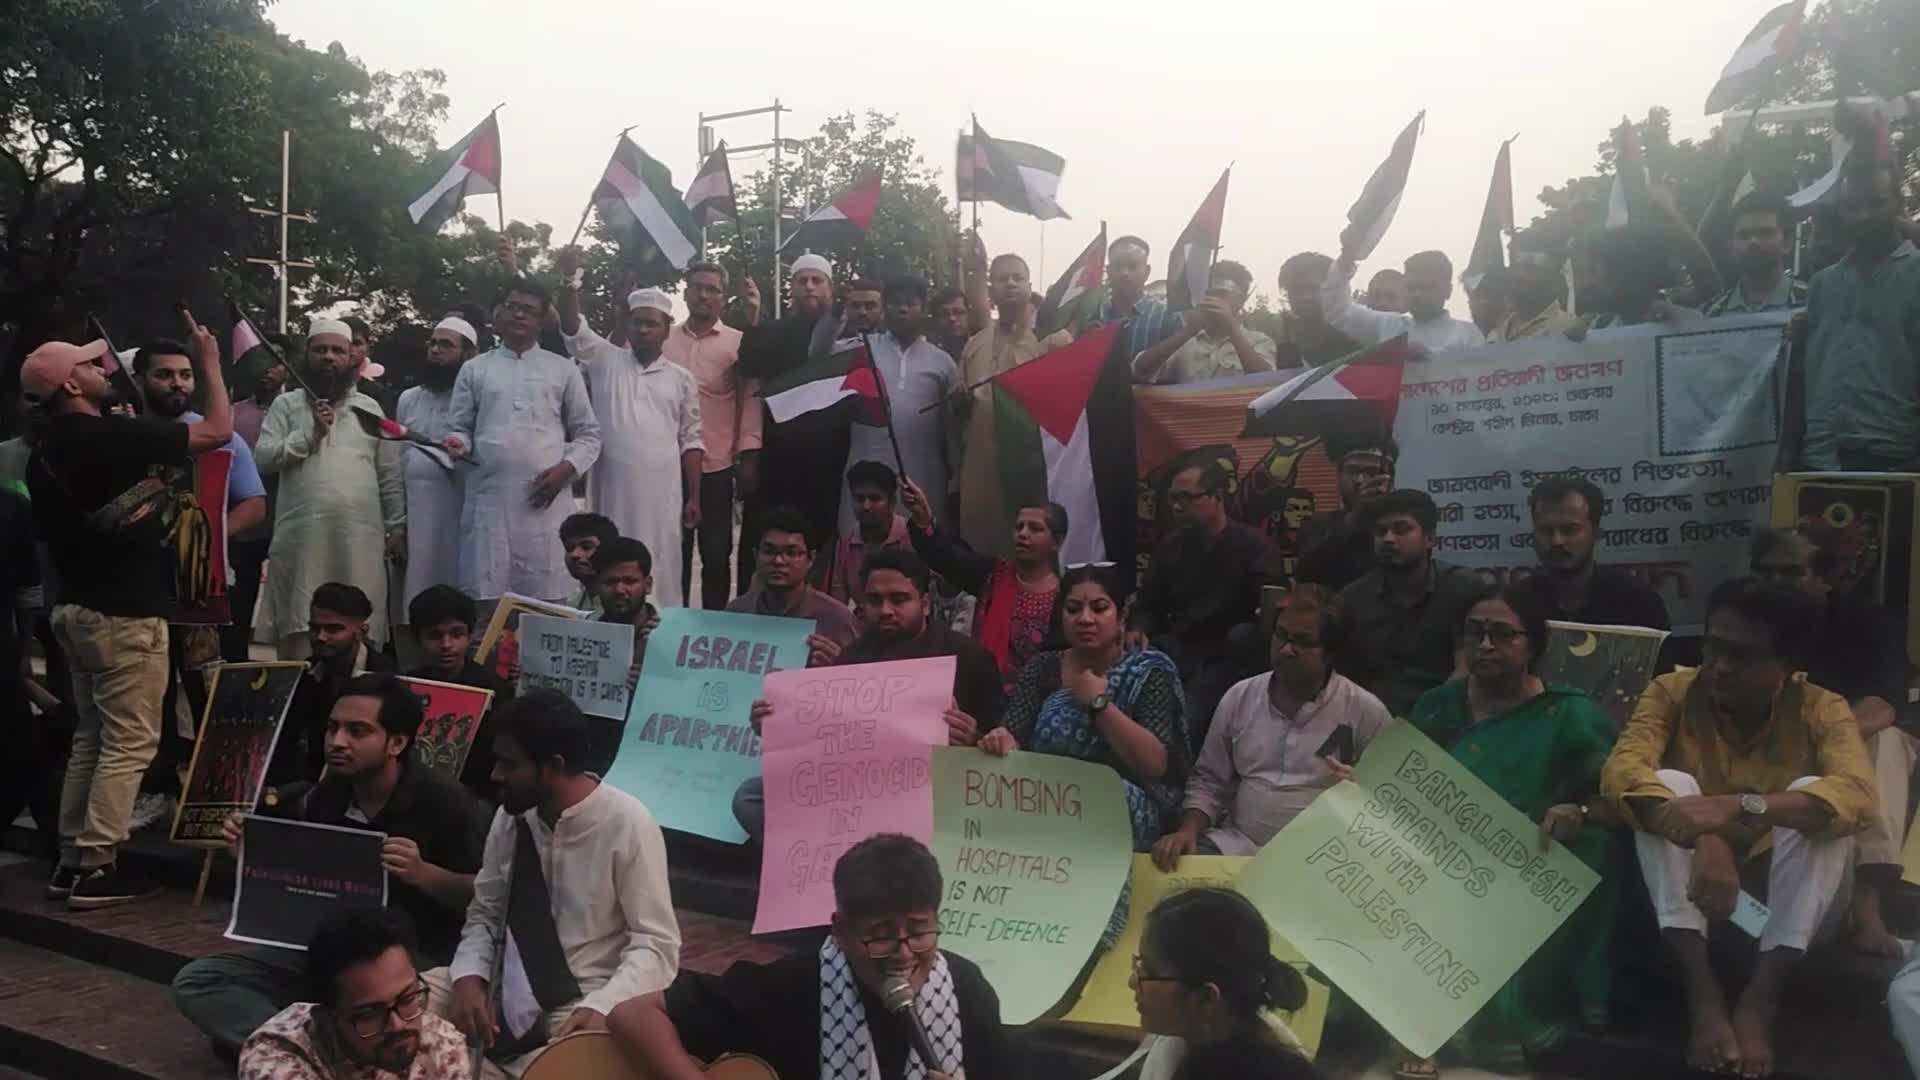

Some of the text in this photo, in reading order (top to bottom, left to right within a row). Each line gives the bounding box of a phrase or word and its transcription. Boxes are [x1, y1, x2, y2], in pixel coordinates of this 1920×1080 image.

[675, 634, 784, 674] ISRAEL
[695, 680, 729, 712] IS
[794, 674, 917, 725] STOP
[639, 711, 763, 758] APARTHIE
[815, 719, 877, 756] THE
[789, 756, 931, 807] GENOCID
[964, 768, 1083, 822] BOMBING
[963, 816, 983, 841] IN
[1363, 782, 1497, 899] STANDS
[1394, 748, 1579, 913] BANGLADESH
[955, 845, 1073, 884] HOSPITALS
[1345, 812, 1429, 896] WITH
[946, 879, 1014, 906] IS NOT
[938, 907, 1073, 945] SELF-DEFENCE
[1304, 835, 1481, 1001] PALESTINE
